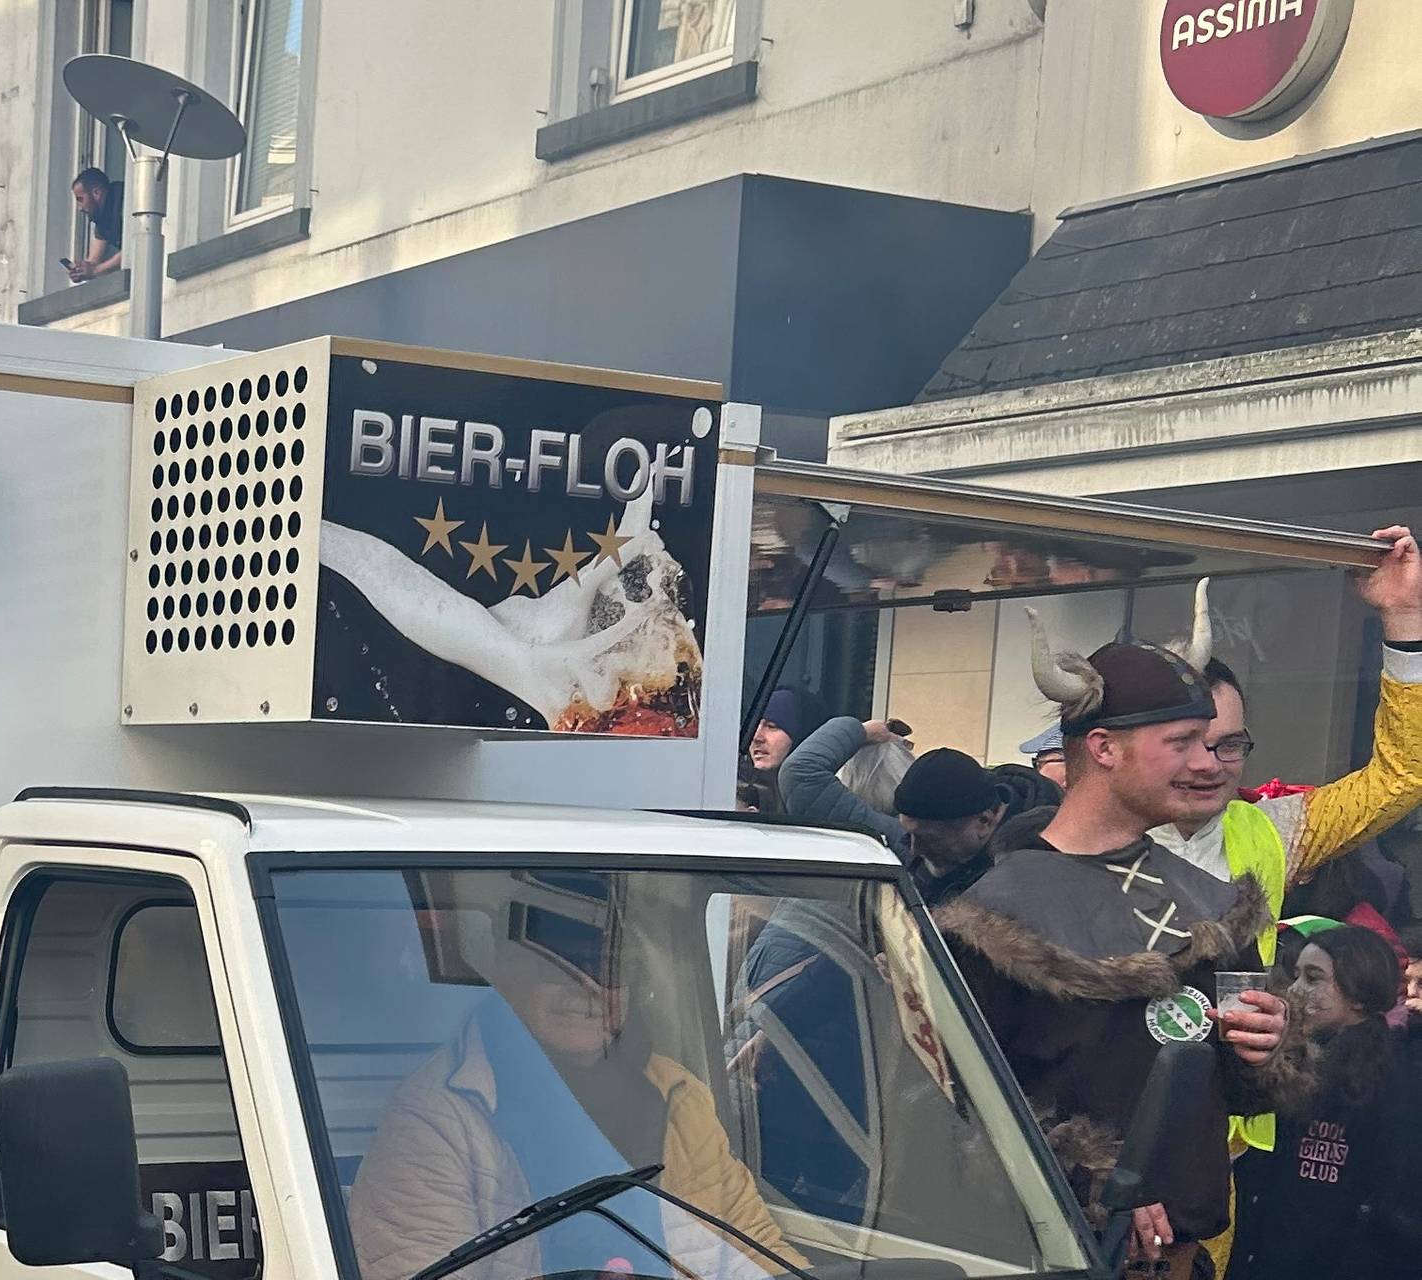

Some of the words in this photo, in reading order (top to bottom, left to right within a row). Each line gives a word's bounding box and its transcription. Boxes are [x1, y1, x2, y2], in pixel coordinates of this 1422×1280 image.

[1171, 0, 1304, 51] ASSIMA
[349, 408, 696, 508] BIER-FLOH
[1299, 1160, 1339, 1183] CLUB
